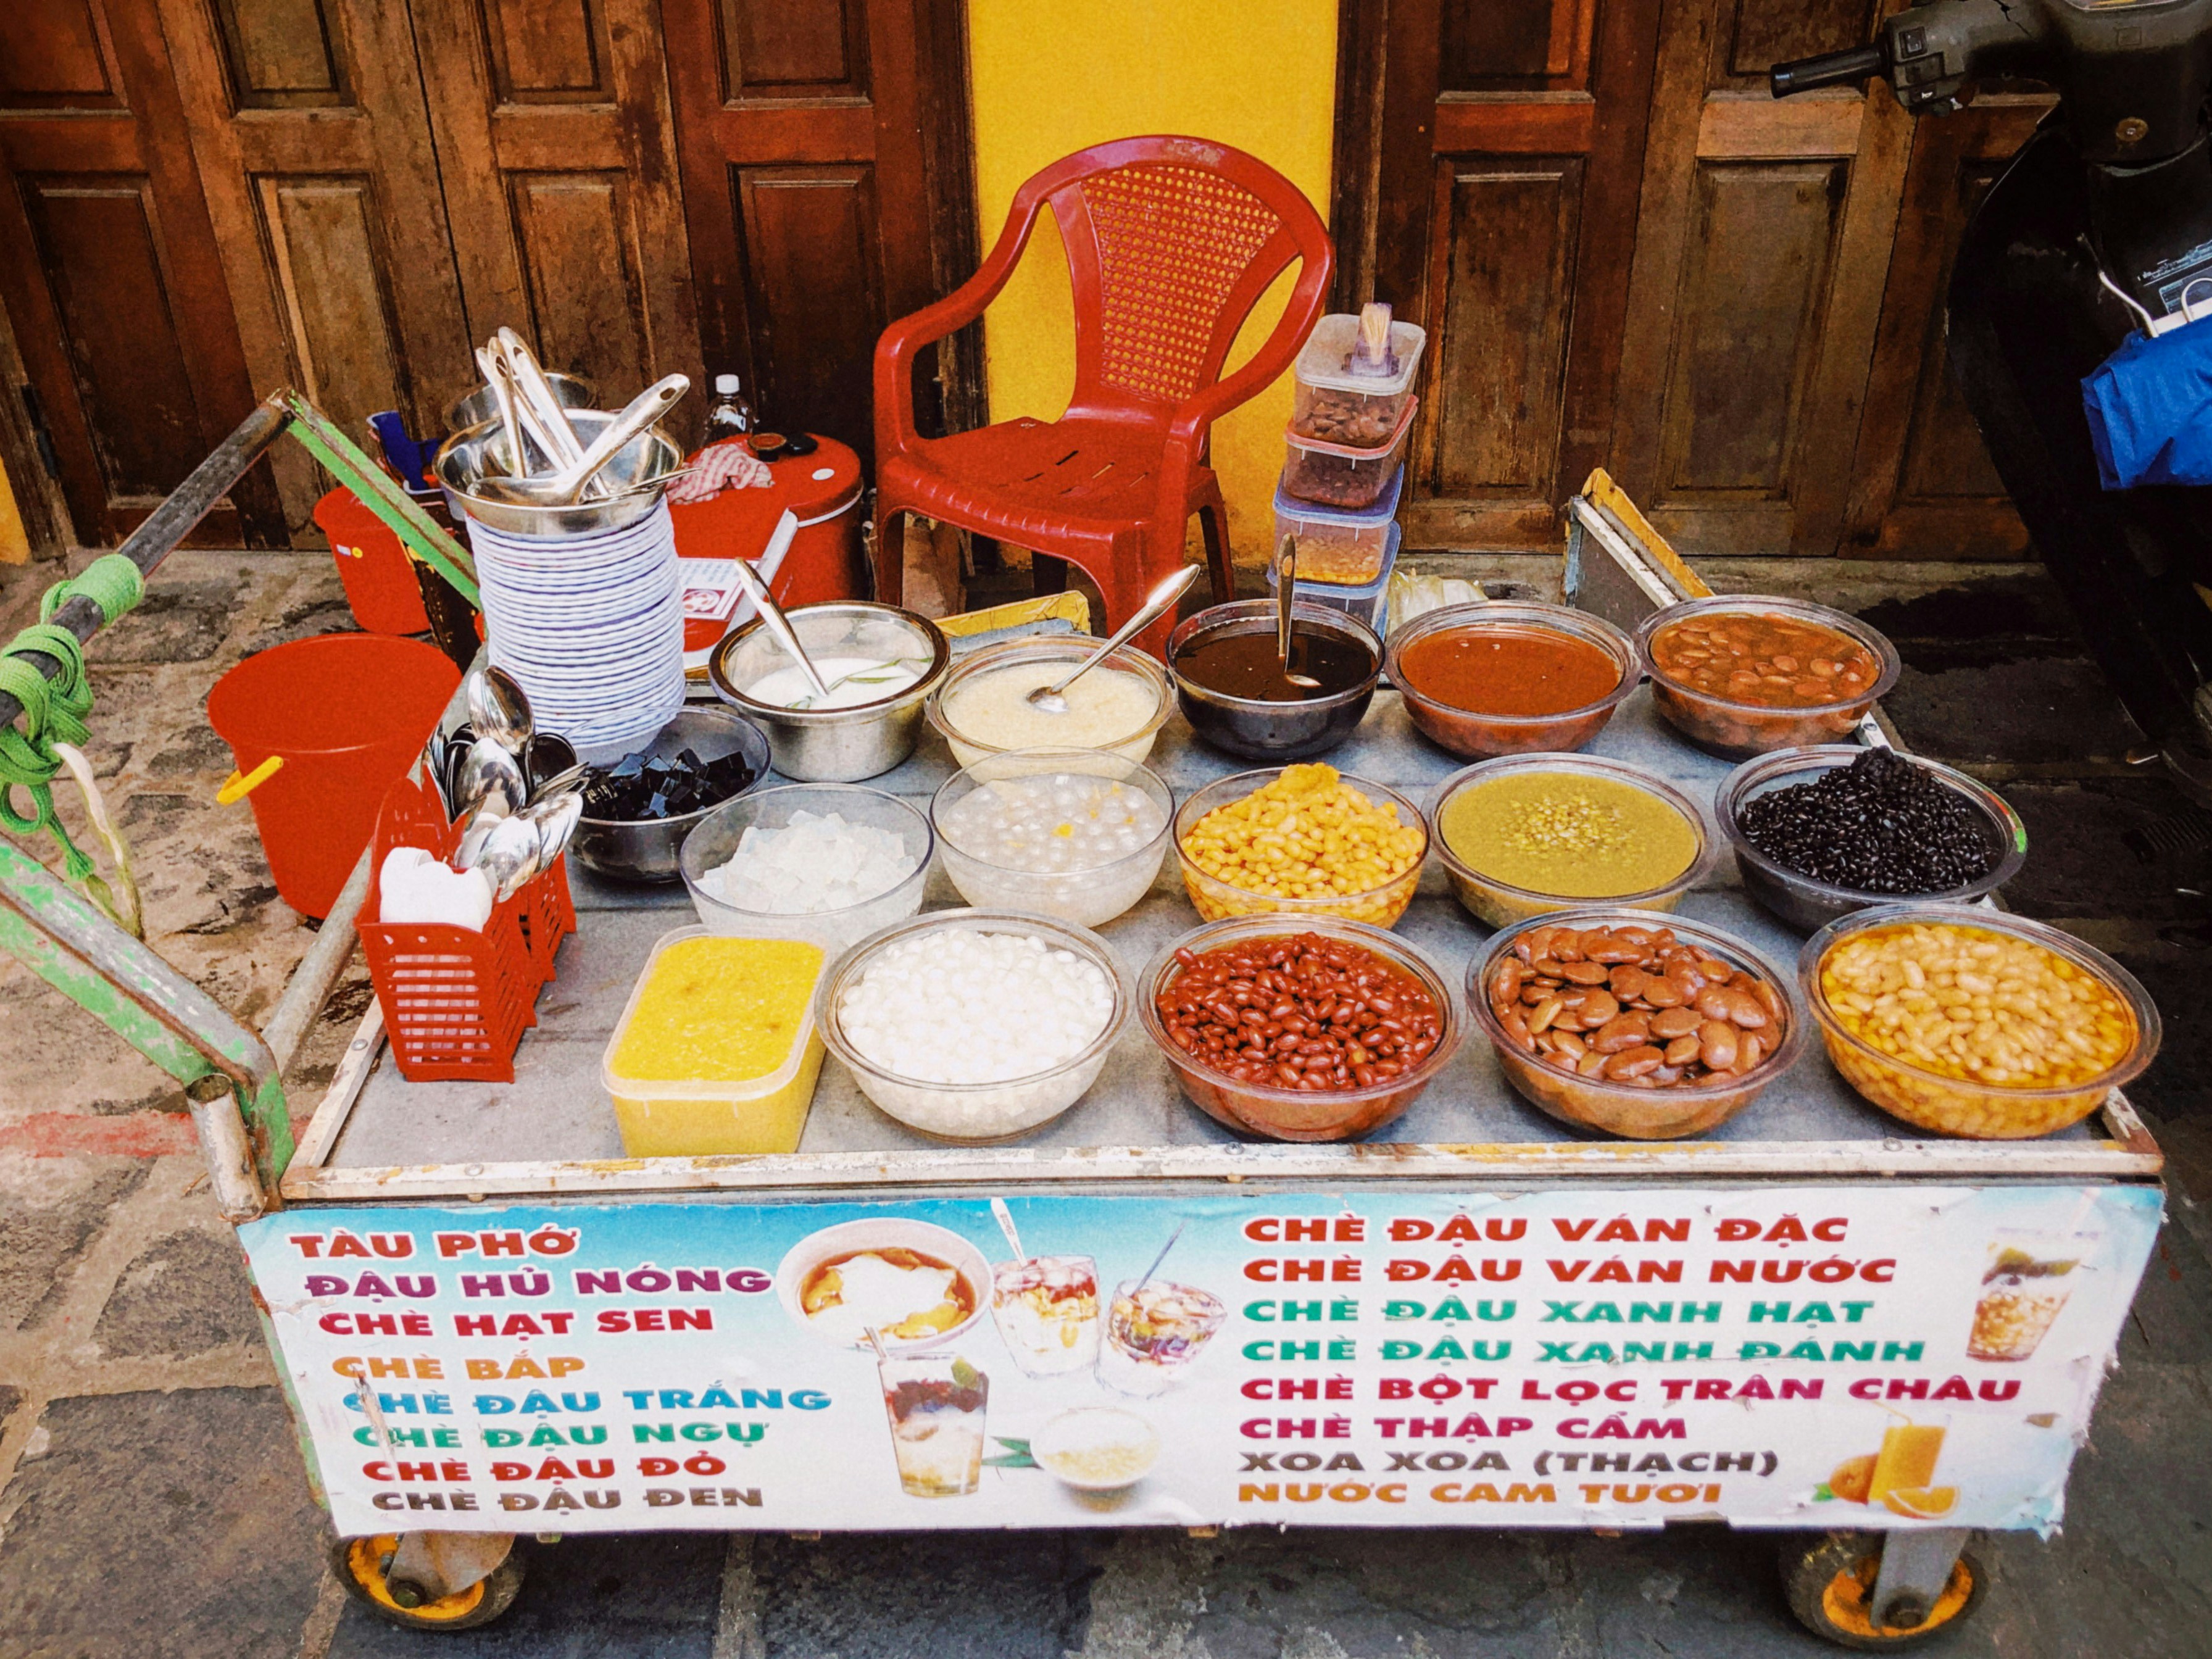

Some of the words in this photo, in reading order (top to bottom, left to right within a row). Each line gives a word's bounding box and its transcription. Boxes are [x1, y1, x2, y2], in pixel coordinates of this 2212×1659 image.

[289, 1230, 413, 1258] TÀU
[437, 1226, 577, 1257] PHỚ
[1244, 1213, 1364, 1241] CHÈ
[1387, 1214, 1527, 1247] ĐẬU
[1551, 1213, 1691, 1242] VÁN
[1715, 1213, 1848, 1247] ĐẶC
[304, 1271, 436, 1303] ĐẬU
[461, 1267, 550, 1297] HỦ
[575, 1265, 771, 1294] NÓNG
[1243, 1254, 1362, 1282] CHÈ
[1384, 1254, 1522, 1287] ĐẬU
[1545, 1255, 1684, 1283] VÁN
[1709, 1254, 1897, 1283] NƯỚC
[319, 1310, 433, 1336] CHÈ
[454, 1312, 574, 1341] HẠT
[597, 1309, 713, 1333] SEN
[1242, 1295, 1358, 1321] CHÈ
[1381, 1295, 1517, 1327] ĐẬU
[1539, 1301, 1723, 1323] XANH
[1747, 1301, 1874, 1328] HẠT
[333, 1353, 445, 1379] CHÈ
[465, 1349, 585, 1380] BẮP
[1242, 1335, 1356, 1361] CHÈ
[1378, 1335, 1512, 1366] ĐẬU
[1534, 1341, 1714, 1362] XANH
[1737, 1336, 1926, 1362] ĐÁNH
[472, 1389, 601, 1419] ĐẬU
[623, 1379, 831, 1410] TRẮNG
[1241, 1374, 1354, 1400] CHÈ
[1379, 1373, 1499, 1405] BỘT
[1521, 1379, 1638, 1406] LỌC
[1660, 1374, 1824, 1400] TRÂN
[1848, 1375, 2021, 1401] CHÂU
[483, 1423, 608, 1451] ĐẬU
[632, 1422, 770, 1447] NGỰ
[1240, 1413, 1351, 1439] CHÈ
[1374, 1413, 1534, 1443] THẬP
[1556, 1412, 1687, 1439] CẨM
[362, 1458, 472, 1481] CHÈ
[489, 1457, 615, 1484] ĐẬU
[637, 1450, 726, 1476] ĐỎ
[1237, 1451, 1366, 1471] XOA
[1383, 1450, 1511, 1471] XOA
[1533, 1450, 1778, 1477] (THẠCH)
[372, 1489, 480, 1511] CHÈ
[497, 1487, 621, 1515] ĐẬU
[642, 1487, 763, 1507] ĐEN
[1238, 1478, 1407, 1502] NƯỚC
[1429, 1482, 1557, 1502] CAM
[1579, 1482, 1721, 1503] TƯƠI
